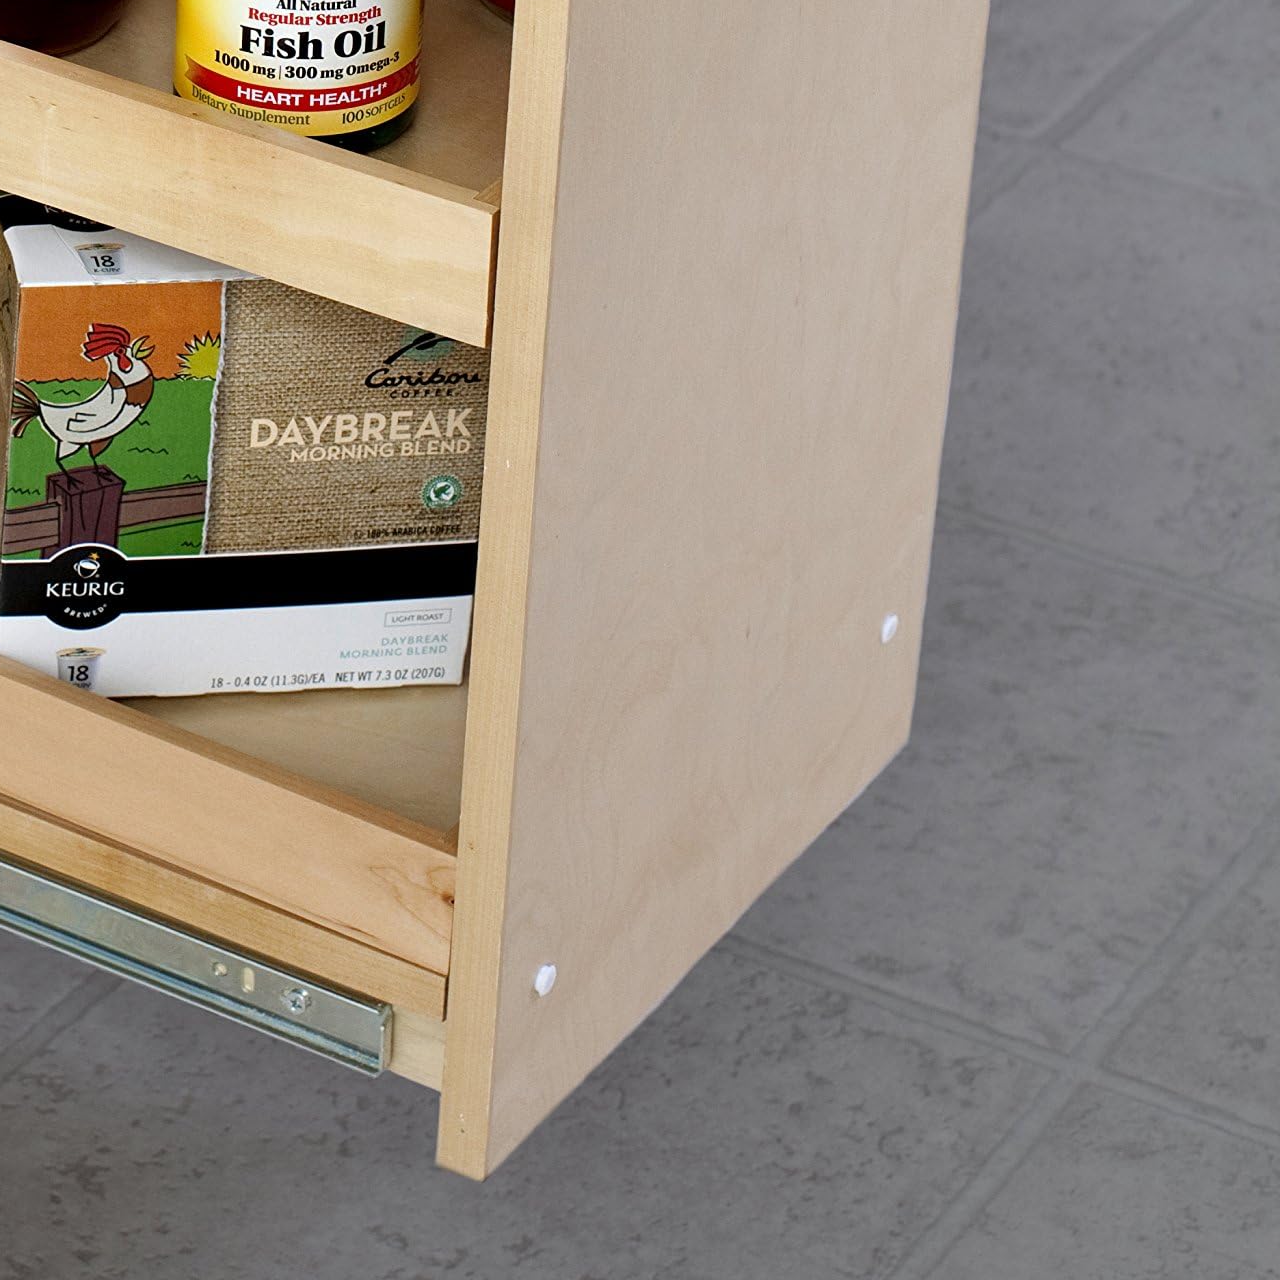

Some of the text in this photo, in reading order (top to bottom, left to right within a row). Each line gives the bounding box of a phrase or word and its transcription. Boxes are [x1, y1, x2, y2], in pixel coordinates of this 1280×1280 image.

[248, 5, 382, 26] Regular Strength
[239, 21, 387, 60] Fish Oil
[214, 50, 400, 80] 1000 mg 300 mg Omega-3
[192, 85, 406, 125] Dietary Supplement 100 SOFTGELS
[237, 86, 304, 106] HEART
[90, 255, 115, 268] 18
[365, 367, 481, 389] Caribou
[390, 389, 453, 399] COFFEE
[250, 409, 473, 448] DAYBREAK
[289, 439, 471, 463] MORNING BLEND
[392, 526, 427, 536] ARABICA
[430, 524, 461, 535] COFFEE
[46, 581, 125, 598] KEURIG
[391, 612, 444, 624] LIGHT ROAST
[381, 633, 448, 647] DAYBREAK
[340, 645, 447, 659] MORNING BLEND
[67, 665, 89, 682] 18
[210, 667, 446, 688] 18 0.4 OZ (11.3G)/EA NET WT 7.3 OZ (207G)
